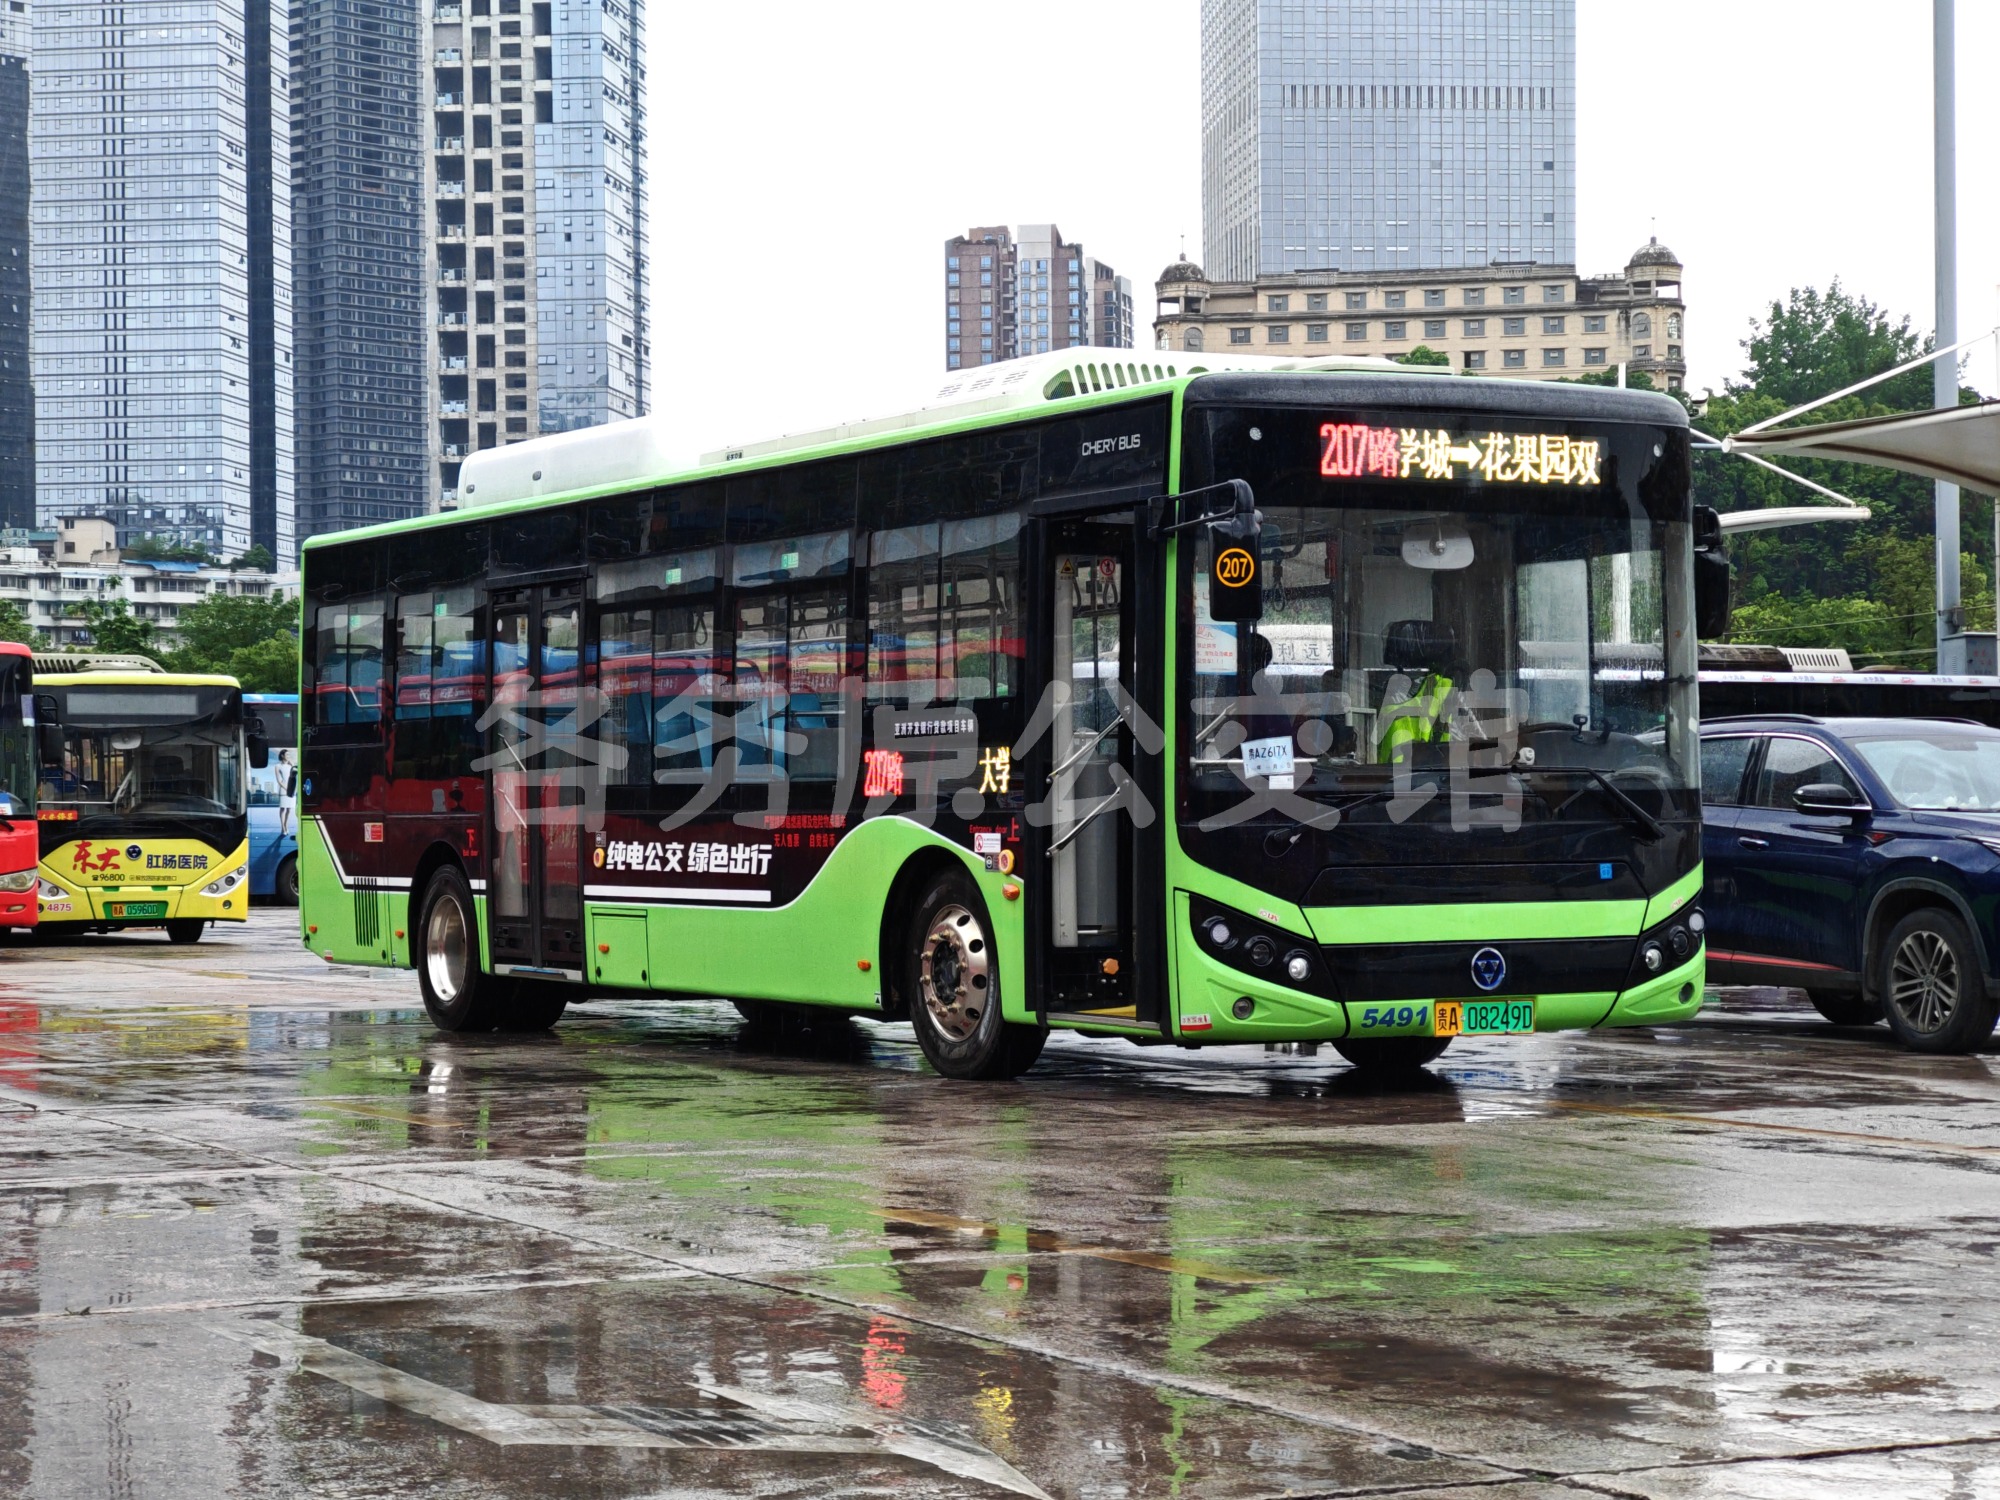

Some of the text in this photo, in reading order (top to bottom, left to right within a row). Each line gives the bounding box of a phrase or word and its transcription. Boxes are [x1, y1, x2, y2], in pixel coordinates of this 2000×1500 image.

[1081, 434, 1141, 456] CHERY BUS
[1320, 424, 1400, 478] 207路
[1222, 557, 1248, 578] 207
[894, 719, 974, 736] 亚洲开发银行贷款项目车辆
[864, 746, 1011, 796] 207路 大学
[773, 832, 836, 848] 无人售票 自觉投币
[1007, 816, 1021, 842] 上
[73, 840, 208, 874] 东大 肛肠医院
[606, 840, 773, 875] 纯电公交 绿色出行
[99, 873, 125, 882] 96800
[46, 903, 72, 912] 4875
[1361, 1006, 1428, 1029] 5491
